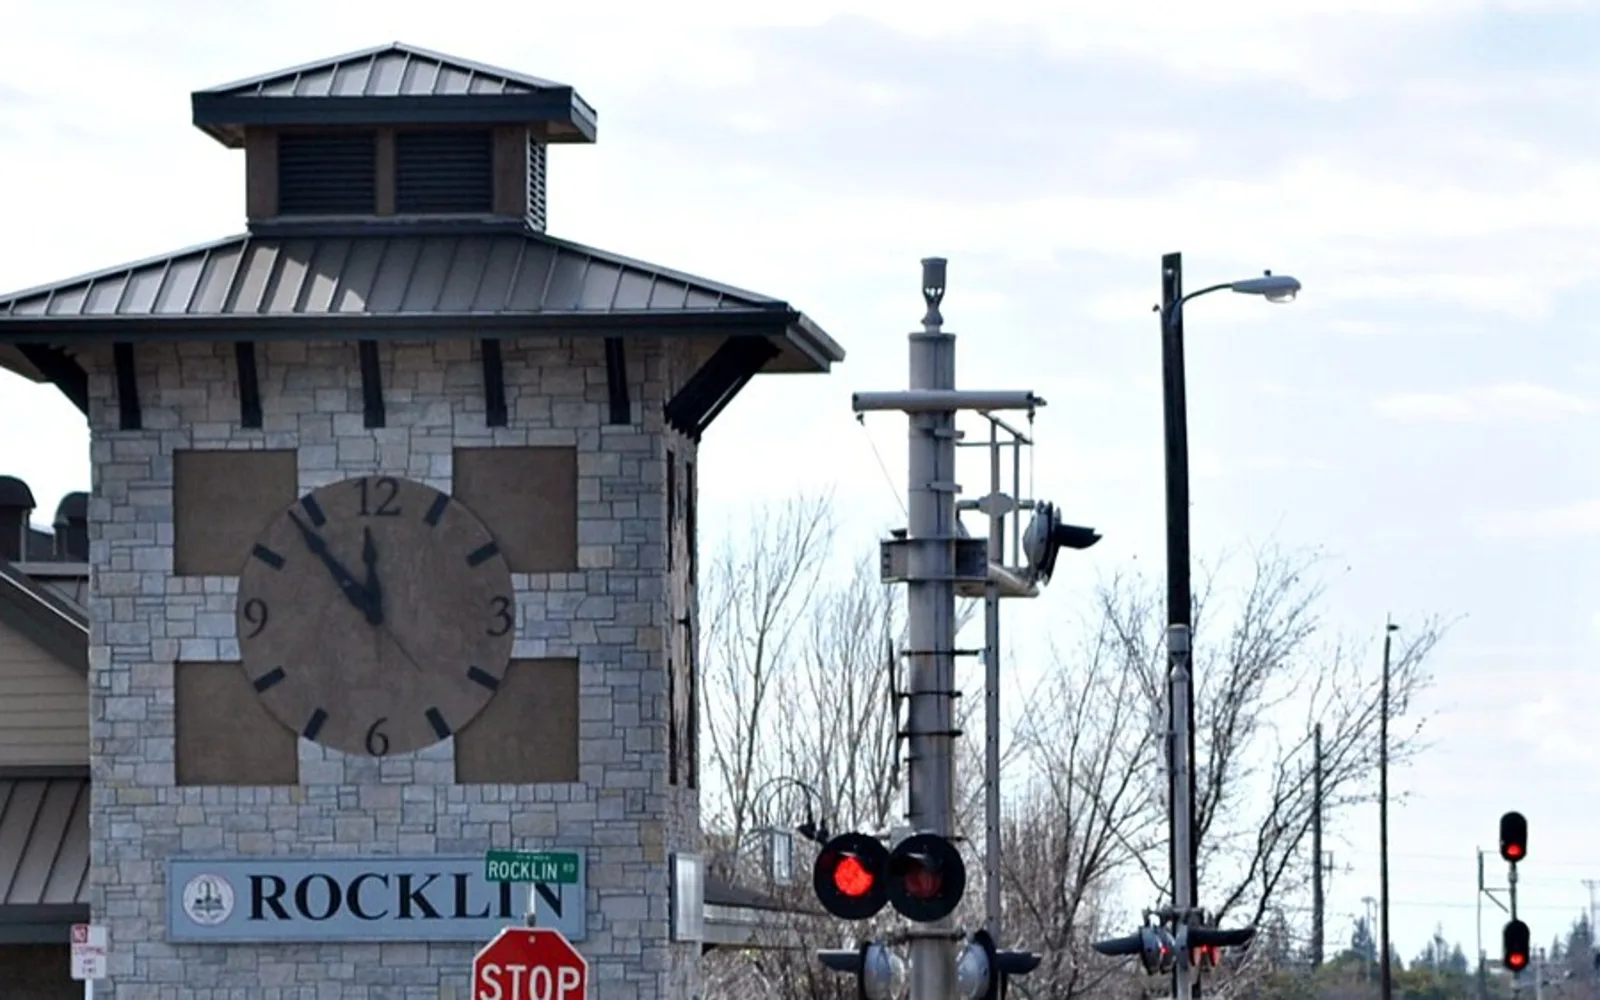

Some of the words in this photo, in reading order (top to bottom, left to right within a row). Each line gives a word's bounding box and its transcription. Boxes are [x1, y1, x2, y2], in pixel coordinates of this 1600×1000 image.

[353, 477, 401, 516] 12
[243, 598, 268, 639] 9
[486, 596, 512, 637] 3
[365, 718, 389, 757] 6
[488, 861, 558, 880] ROCKLIN
[480, 964, 580, 1000] STOP
